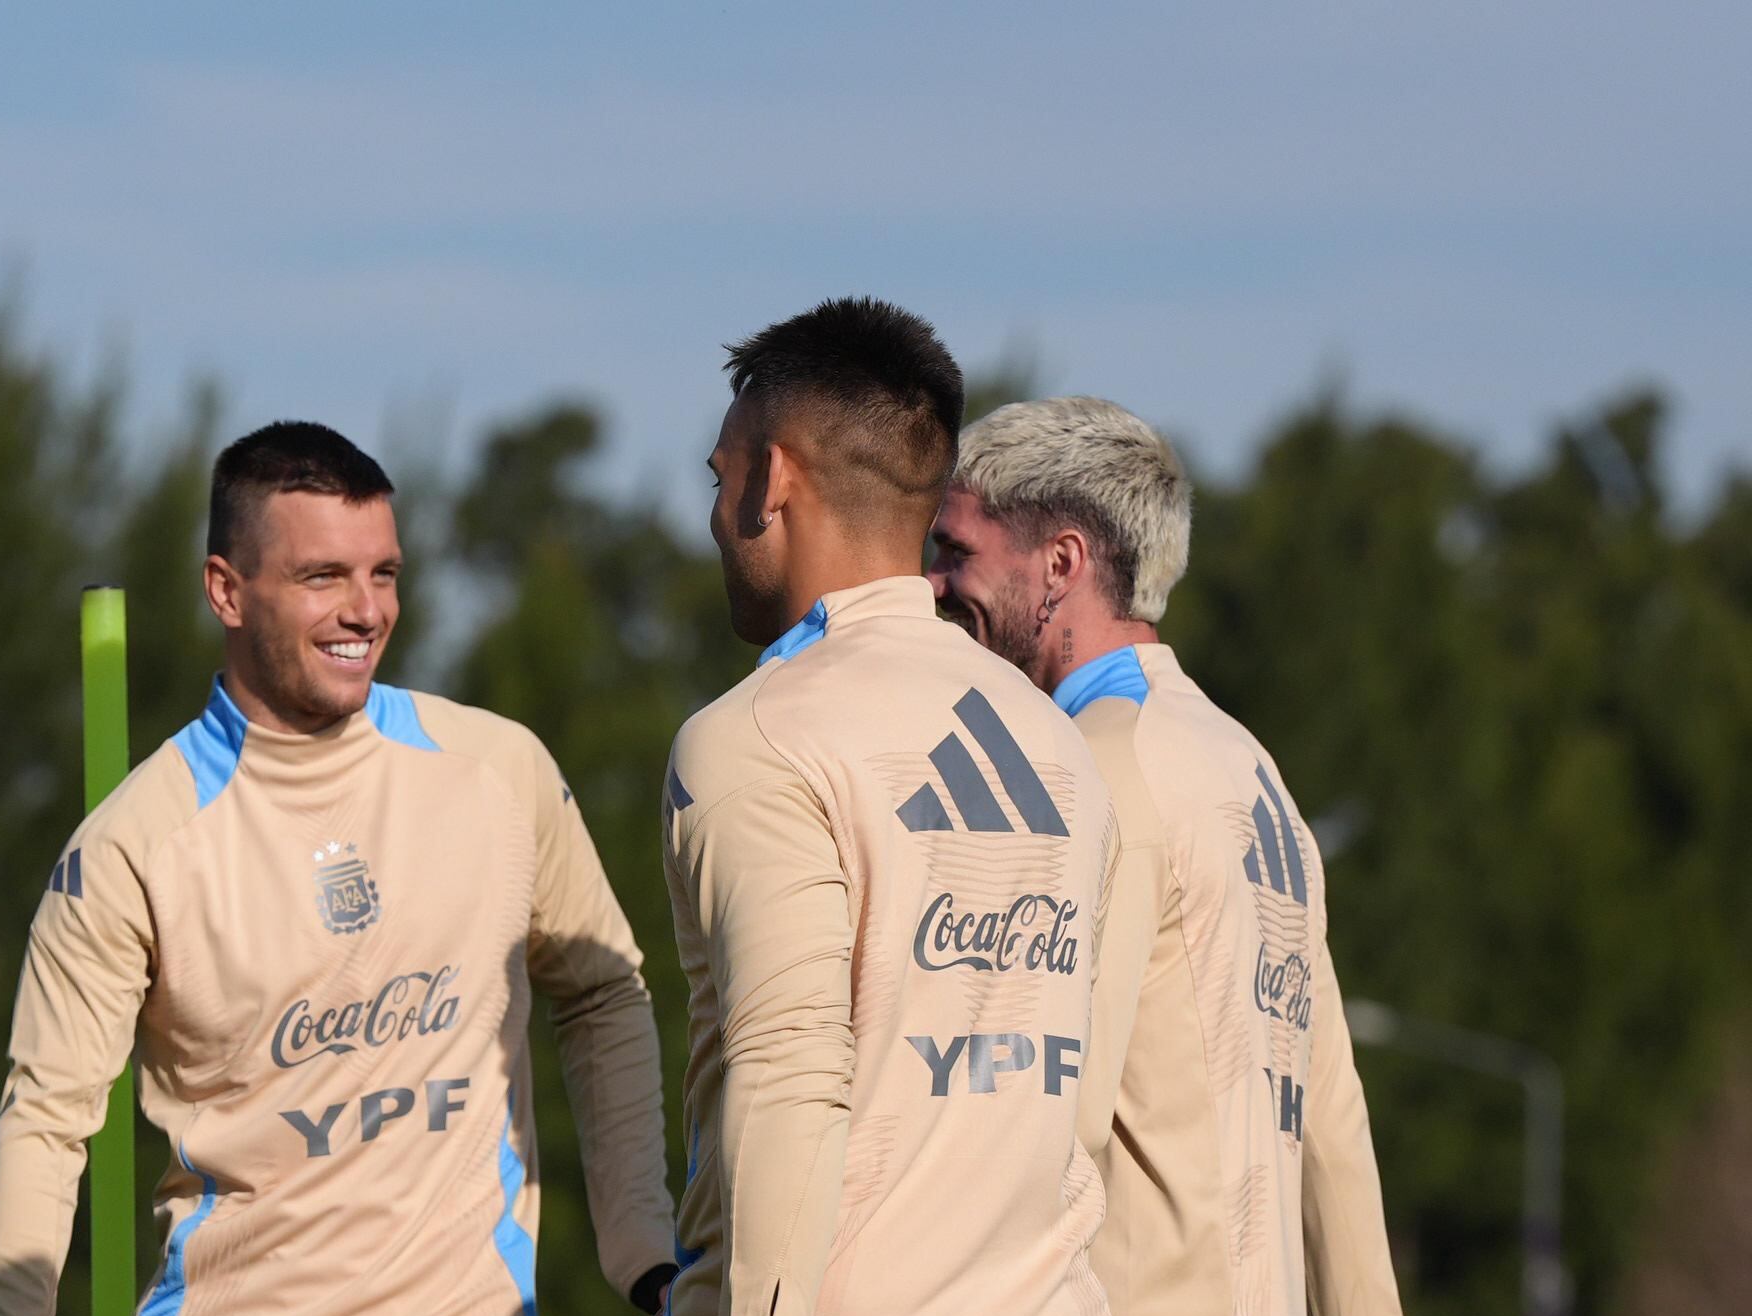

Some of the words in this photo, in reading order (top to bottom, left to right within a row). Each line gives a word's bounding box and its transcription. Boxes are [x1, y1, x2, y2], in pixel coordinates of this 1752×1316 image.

[913, 892, 1079, 976] Coca-Cola
[271, 963, 462, 1069] Coca-Cola
[903, 1032, 1082, 1097] YPF
[278, 1077, 470, 1158] YPF
